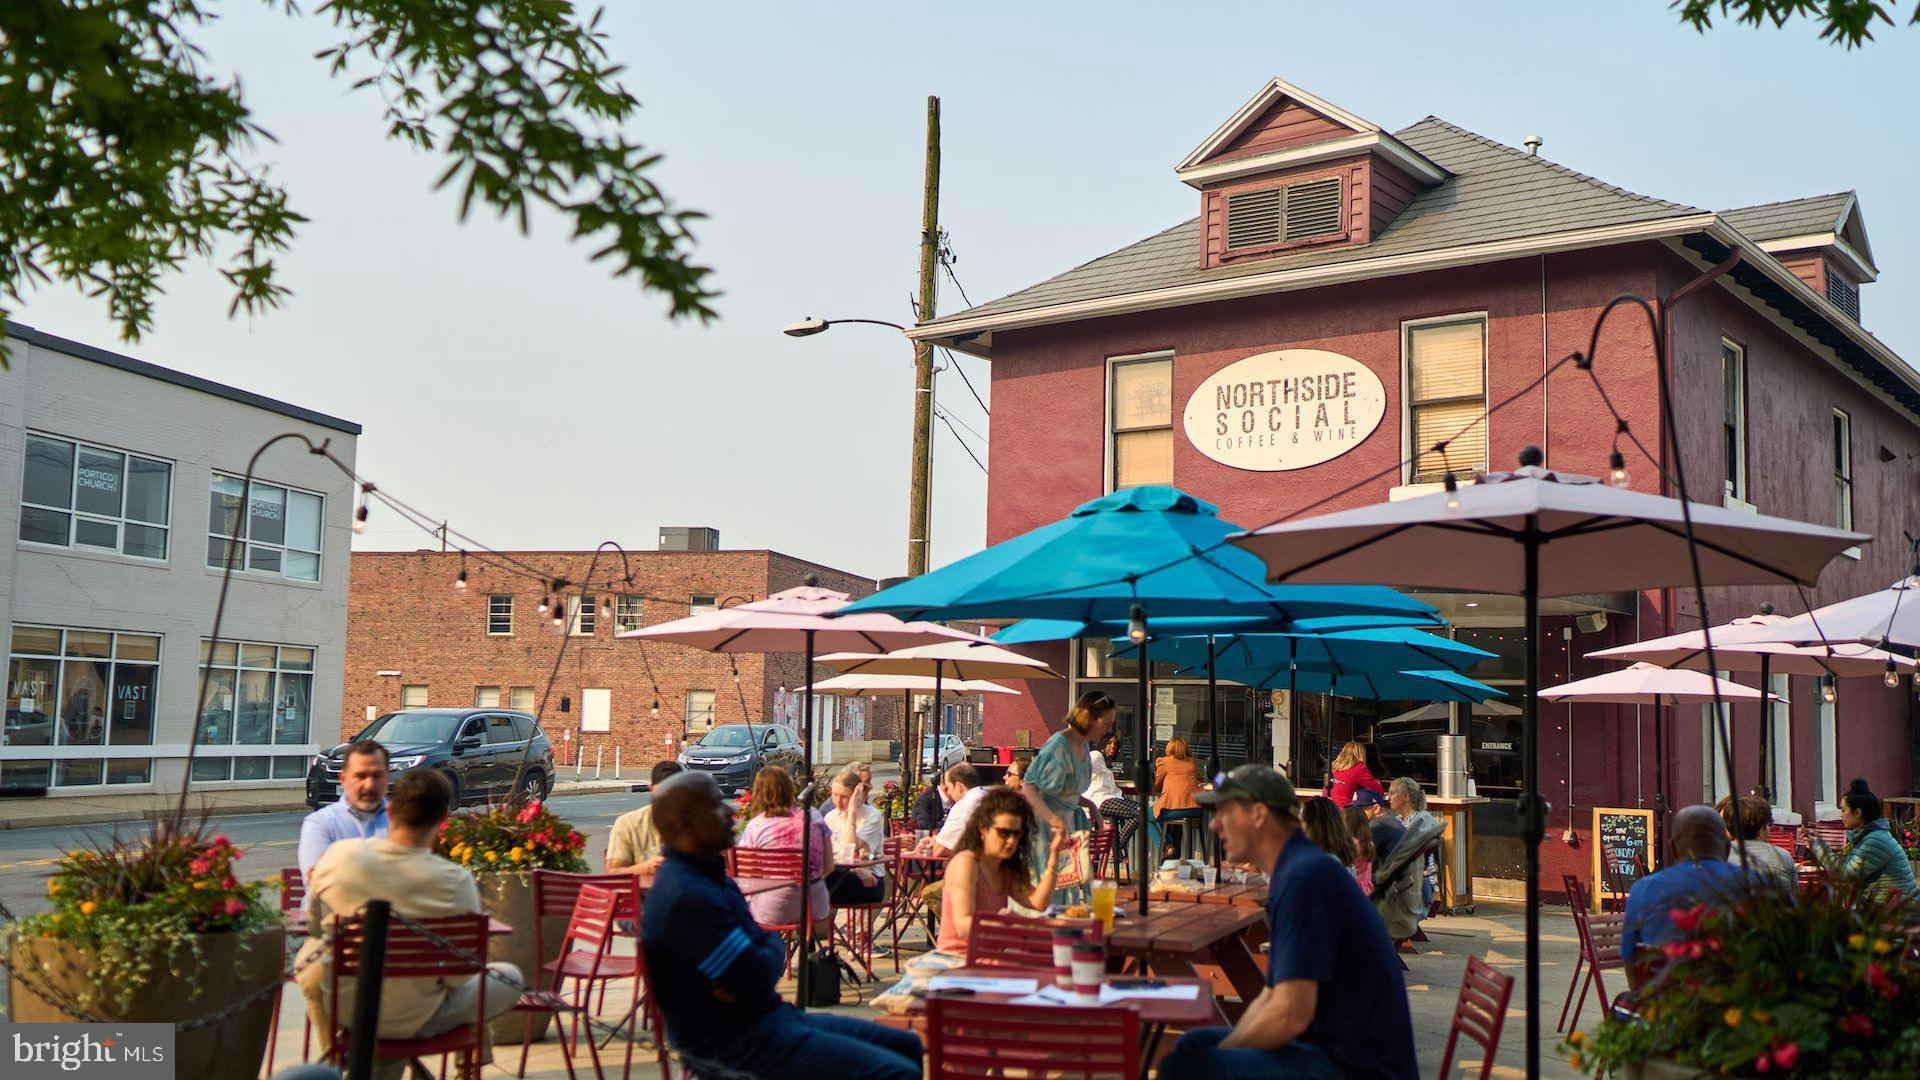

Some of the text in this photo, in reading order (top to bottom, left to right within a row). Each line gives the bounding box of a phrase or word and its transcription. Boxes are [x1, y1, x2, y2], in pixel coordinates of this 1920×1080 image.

[1216, 371, 1356, 410] NORTHSIDE
[1216, 400, 1356, 436] SOCIAL
[1216, 426, 1356, 450] COFFEE & WINE
[79, 467, 114, 482] PORTICO
[78, 477, 114, 491] CHURCH
[13, 680, 46, 697] VAST
[117, 685, 148, 701] VAST
[1481, 742, 1513, 750] ENTRANCE
